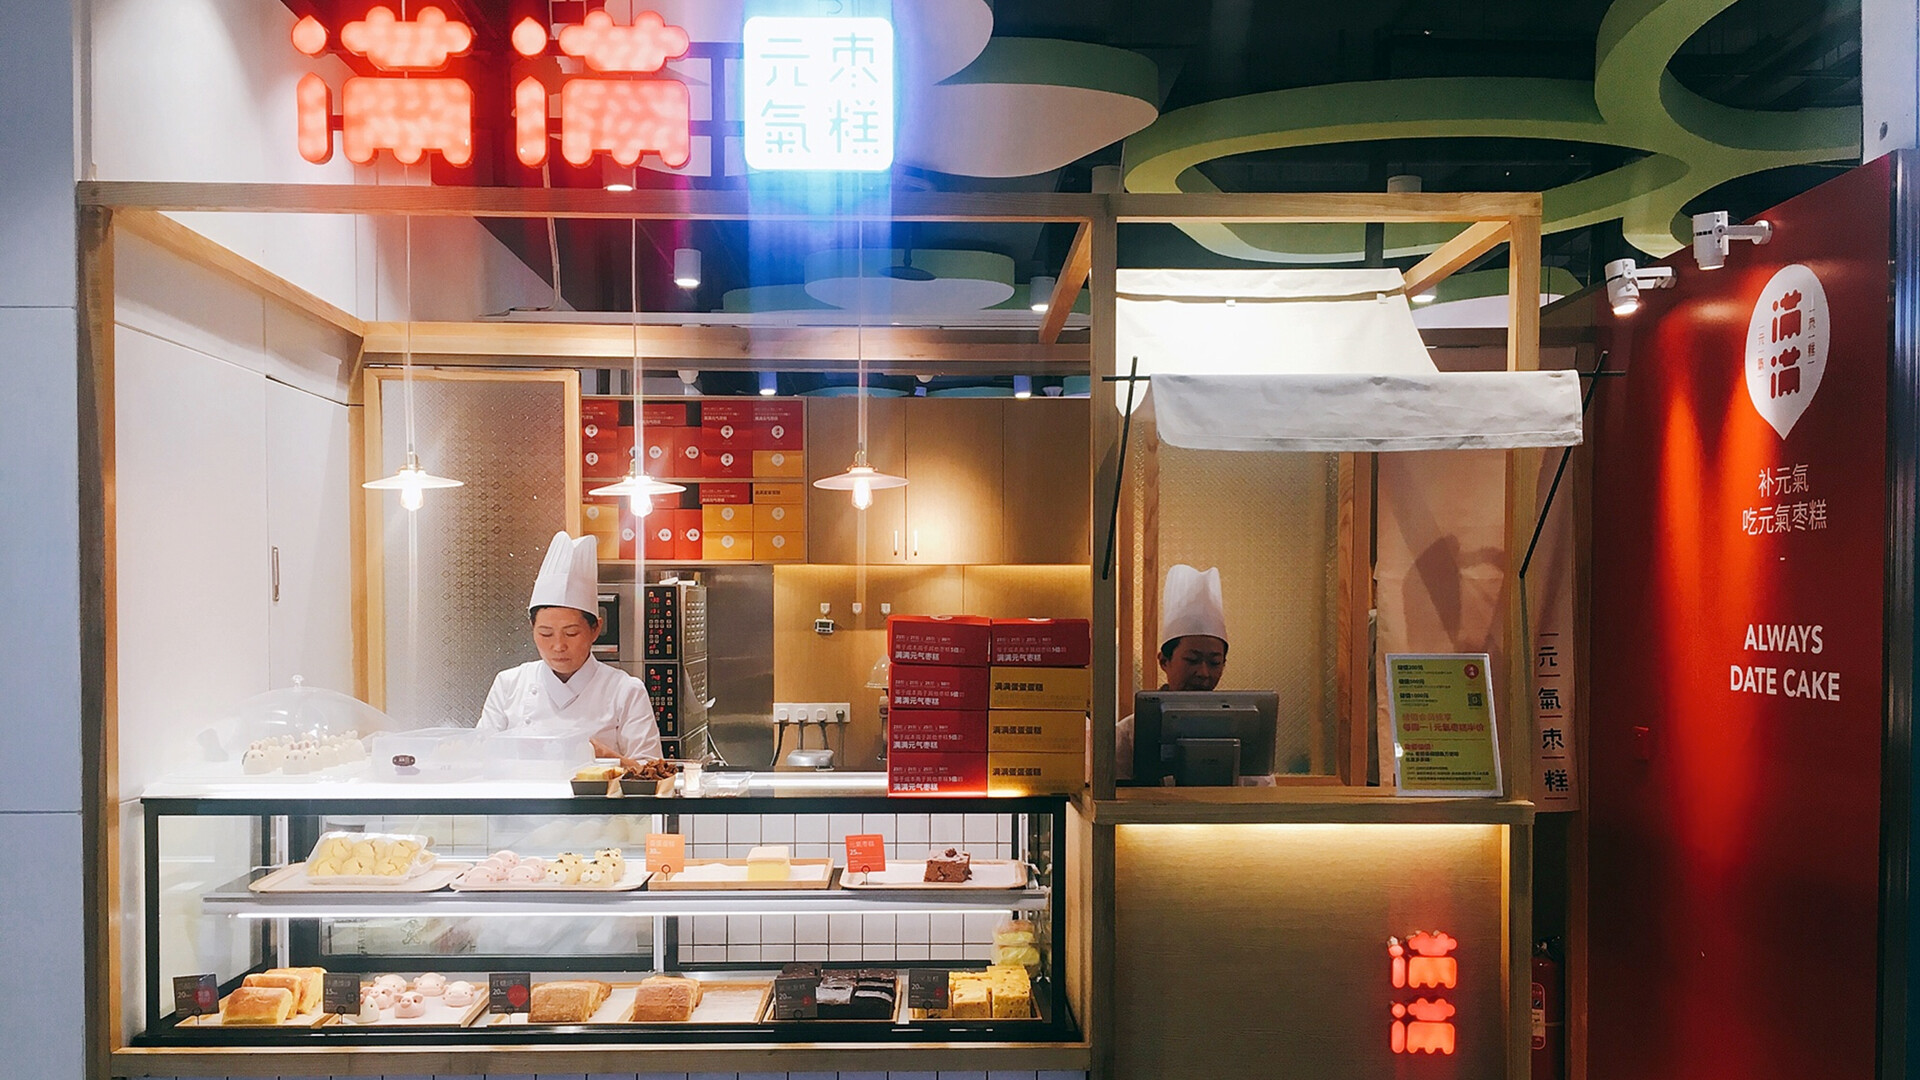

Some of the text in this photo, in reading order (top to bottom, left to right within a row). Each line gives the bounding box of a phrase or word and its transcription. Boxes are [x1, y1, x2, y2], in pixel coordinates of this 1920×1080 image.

[1758, 463, 1809, 498] 补元氣
[1742, 499, 1827, 536] 吃元氣枣糕
[1744, 624, 1823, 654] ALWAYS
[1730, 665, 1840, 702] DATE CAKE
